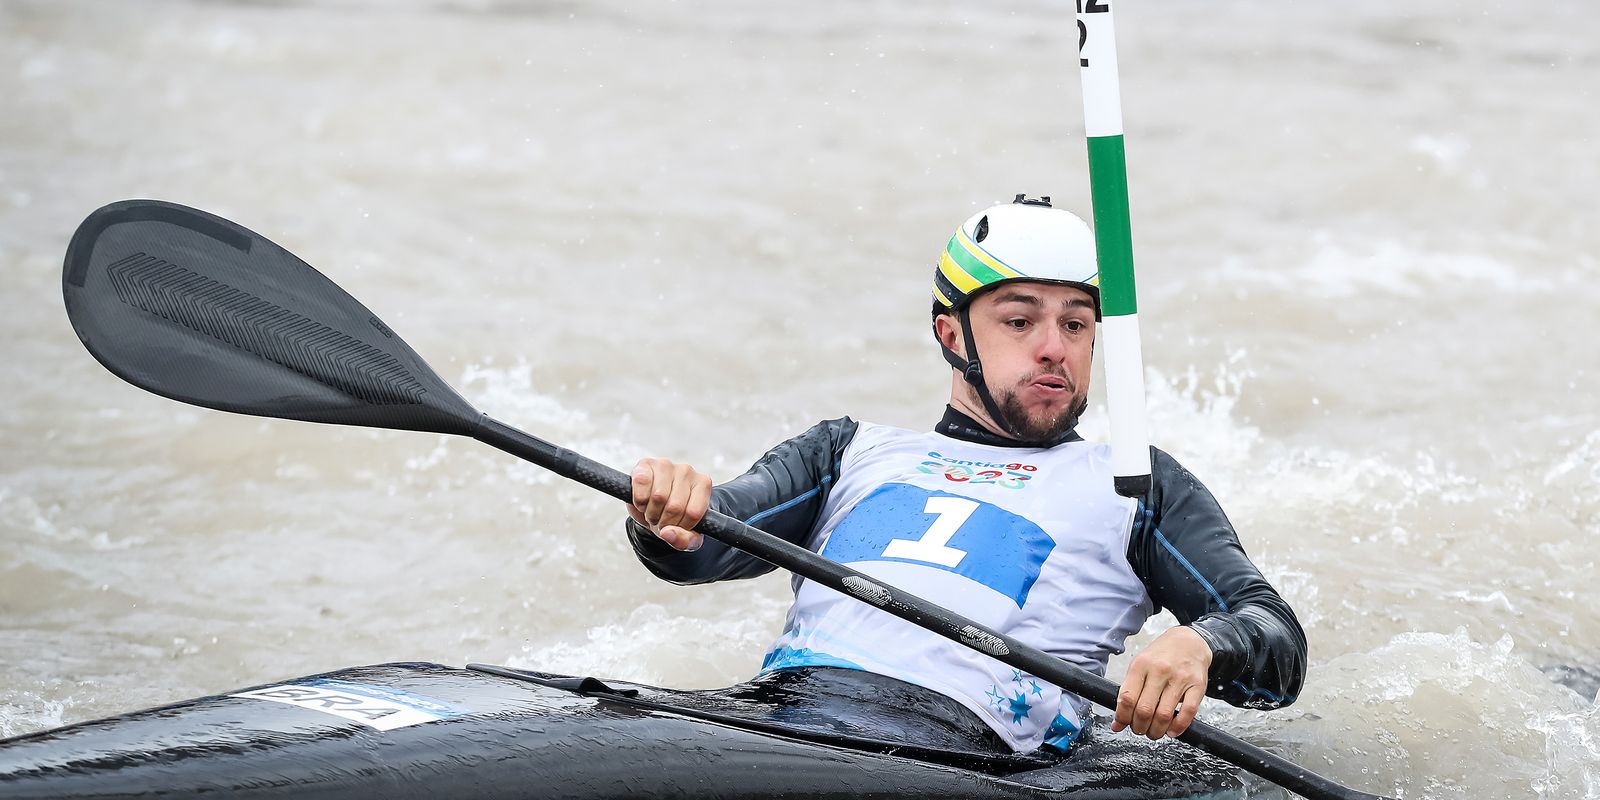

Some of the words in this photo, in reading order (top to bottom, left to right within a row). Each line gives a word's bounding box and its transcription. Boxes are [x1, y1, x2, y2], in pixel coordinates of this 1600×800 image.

[916, 461, 1032, 490] 2023
[880, 496, 980, 568] 1
[252, 688, 401, 720] BRA
